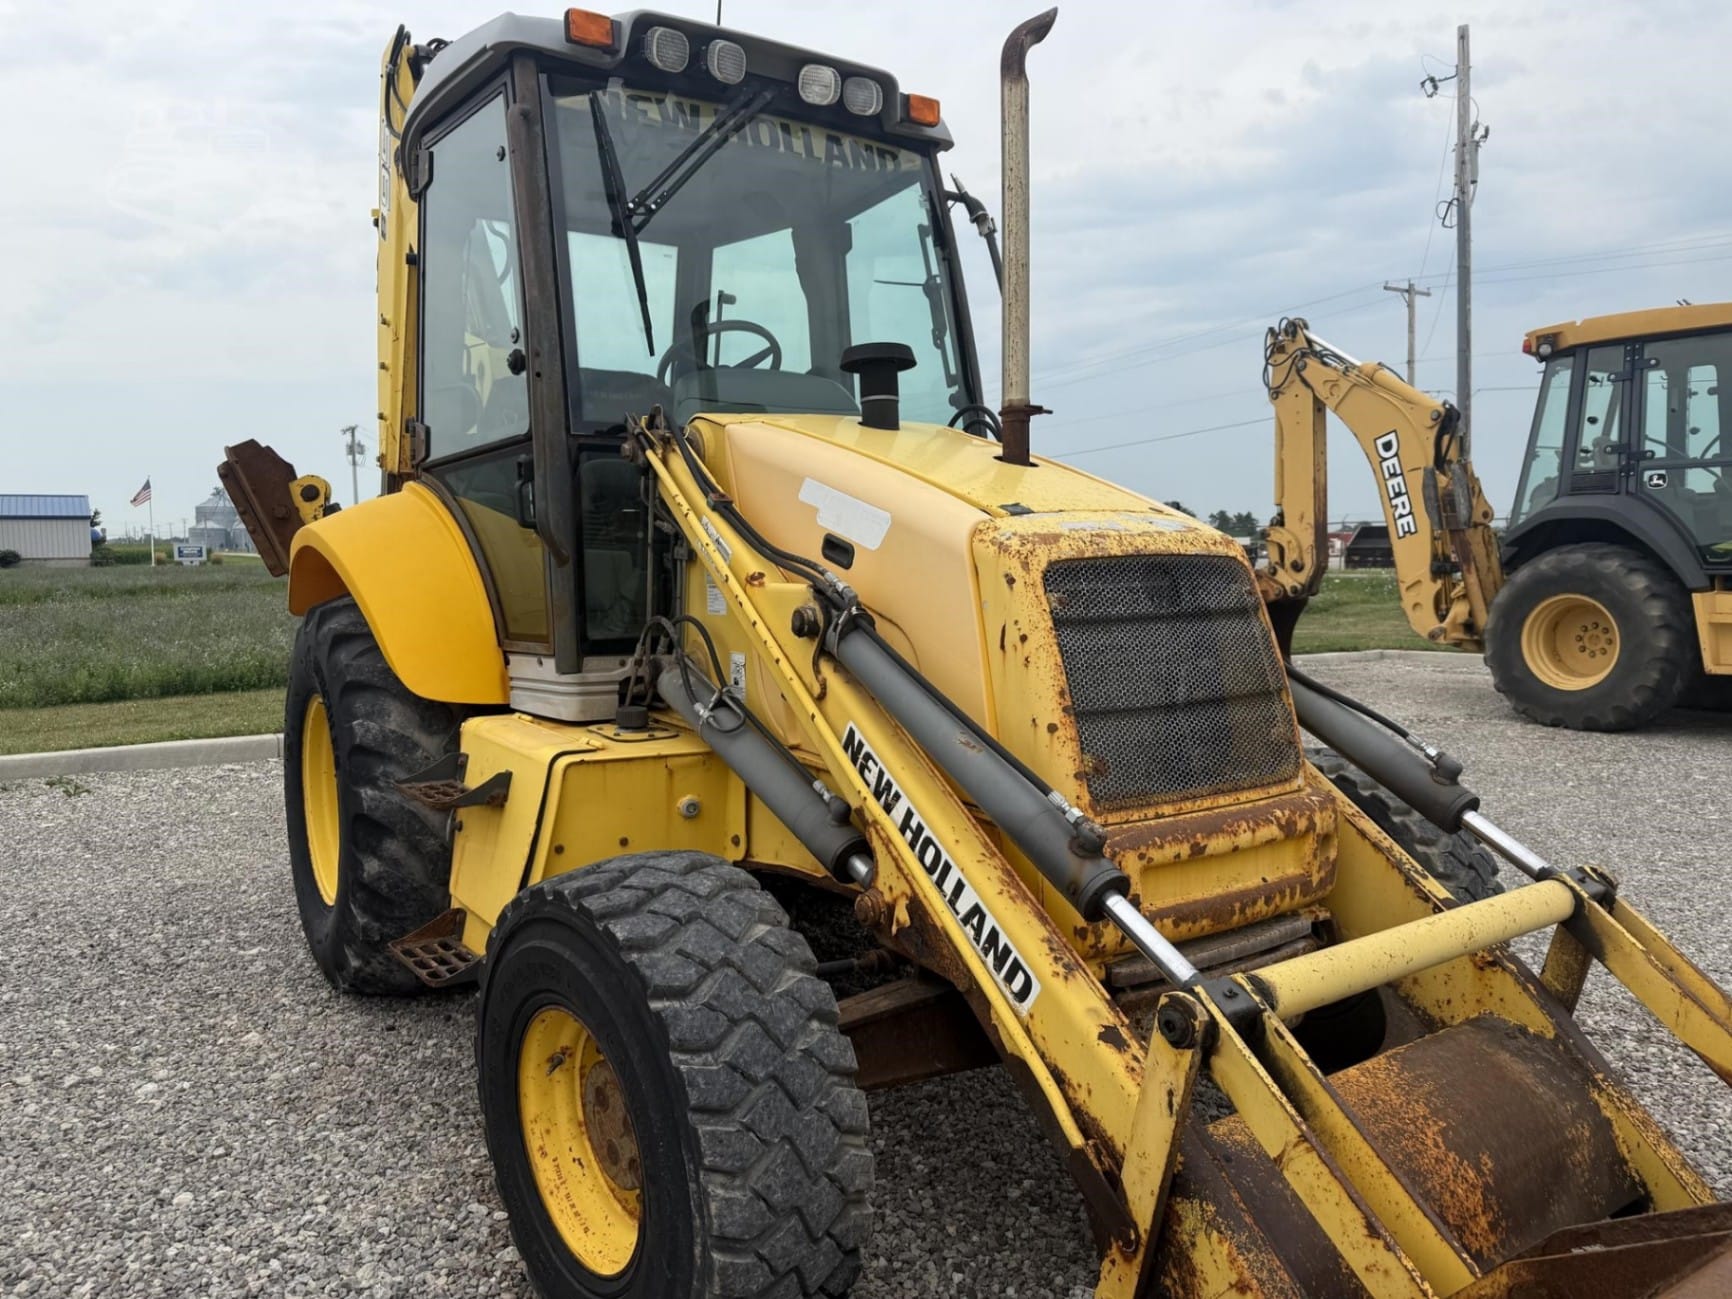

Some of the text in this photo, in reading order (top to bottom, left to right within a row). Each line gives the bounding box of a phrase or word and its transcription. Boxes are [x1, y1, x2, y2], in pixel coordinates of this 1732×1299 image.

[1374, 429, 1418, 539] DEERE
[842, 725, 1034, 1005] NEW HOLLAND
